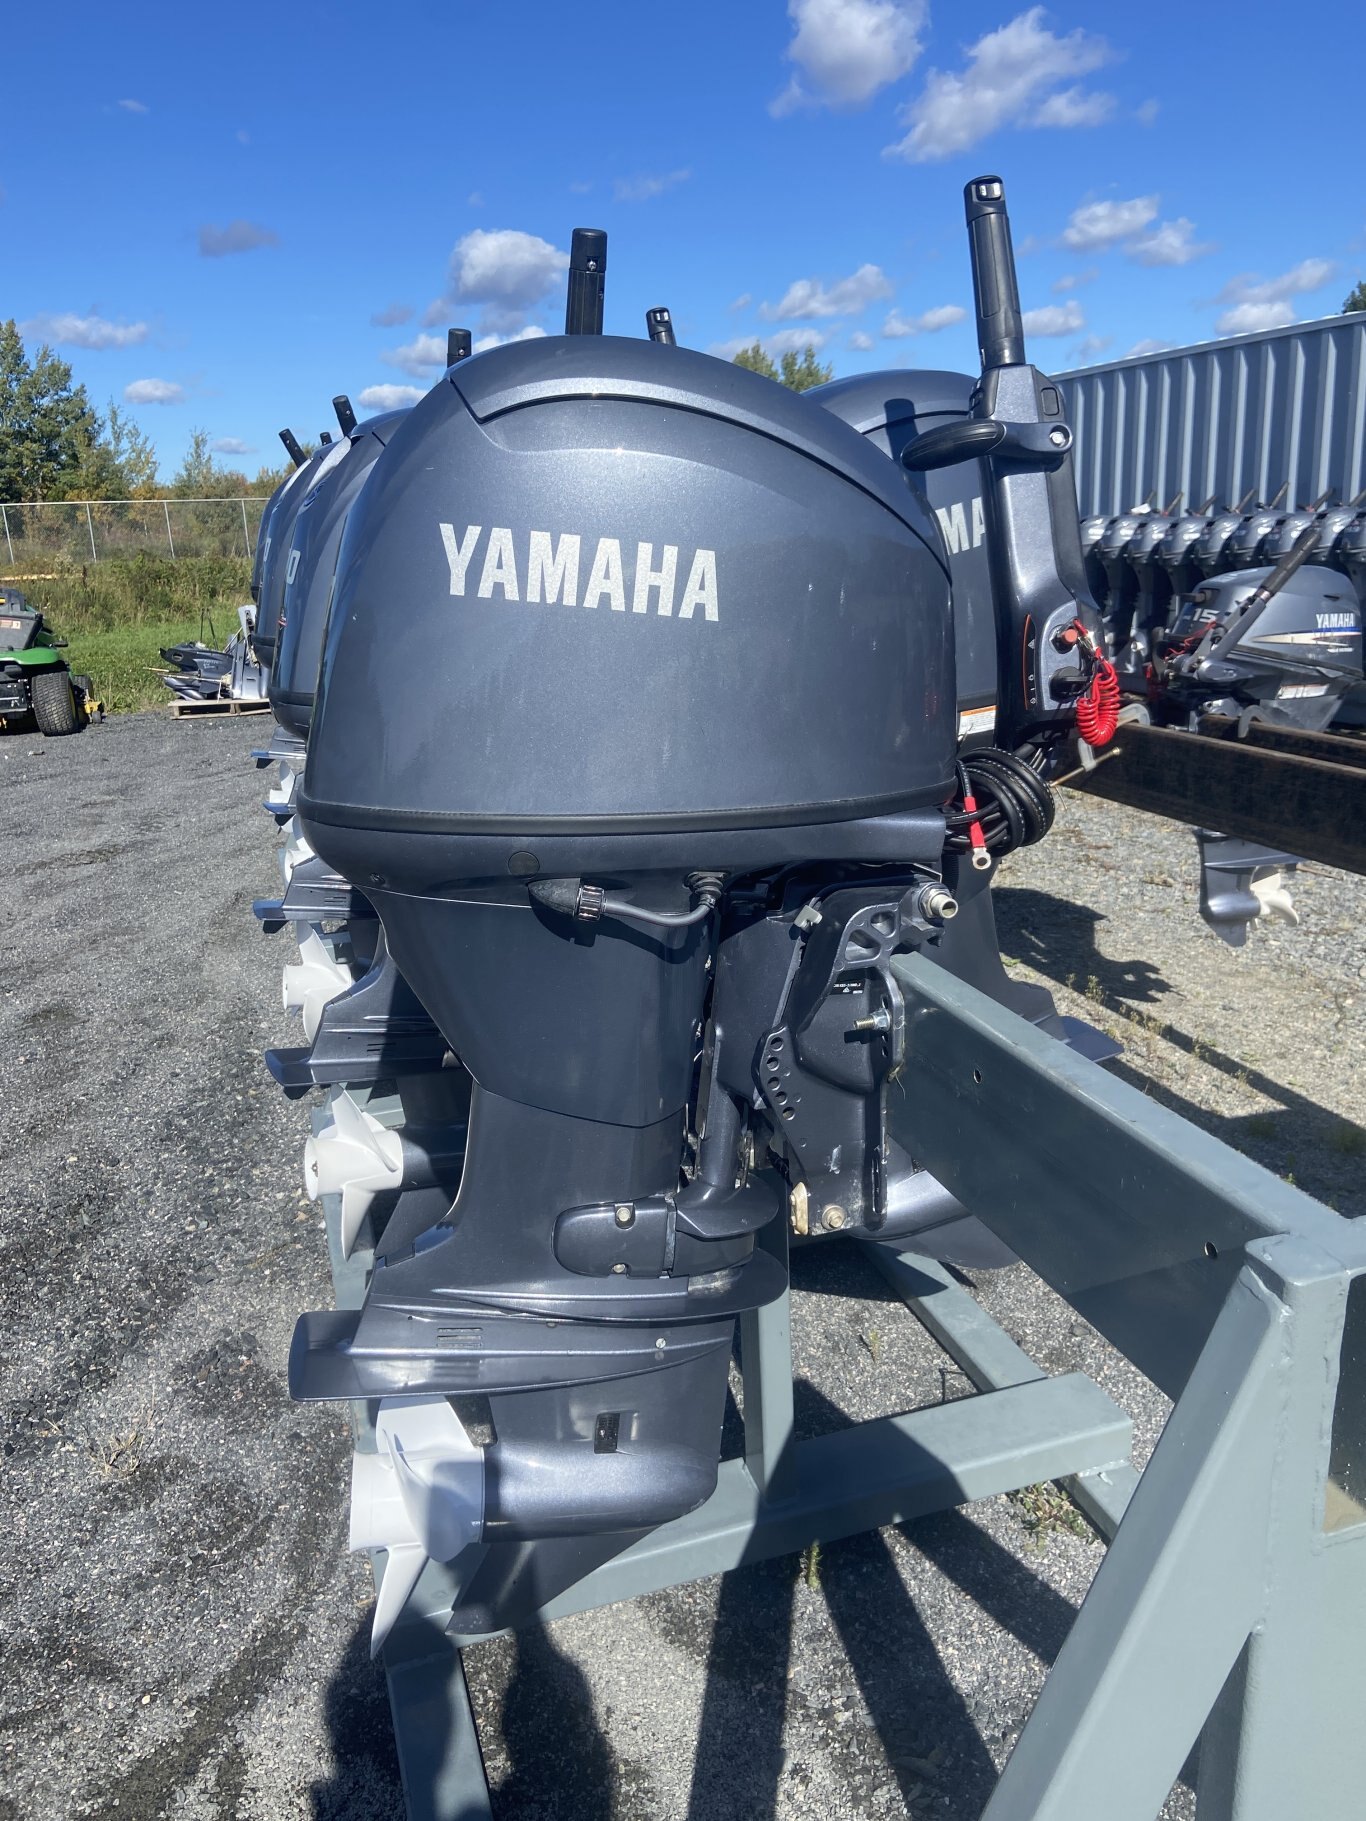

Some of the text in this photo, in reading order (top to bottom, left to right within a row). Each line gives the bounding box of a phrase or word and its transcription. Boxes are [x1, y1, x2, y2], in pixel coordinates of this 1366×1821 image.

[439, 523, 719, 621] YAMAHA
[1193, 608, 1220, 623] 15
[1315, 612, 1355, 628] YAMAHA
